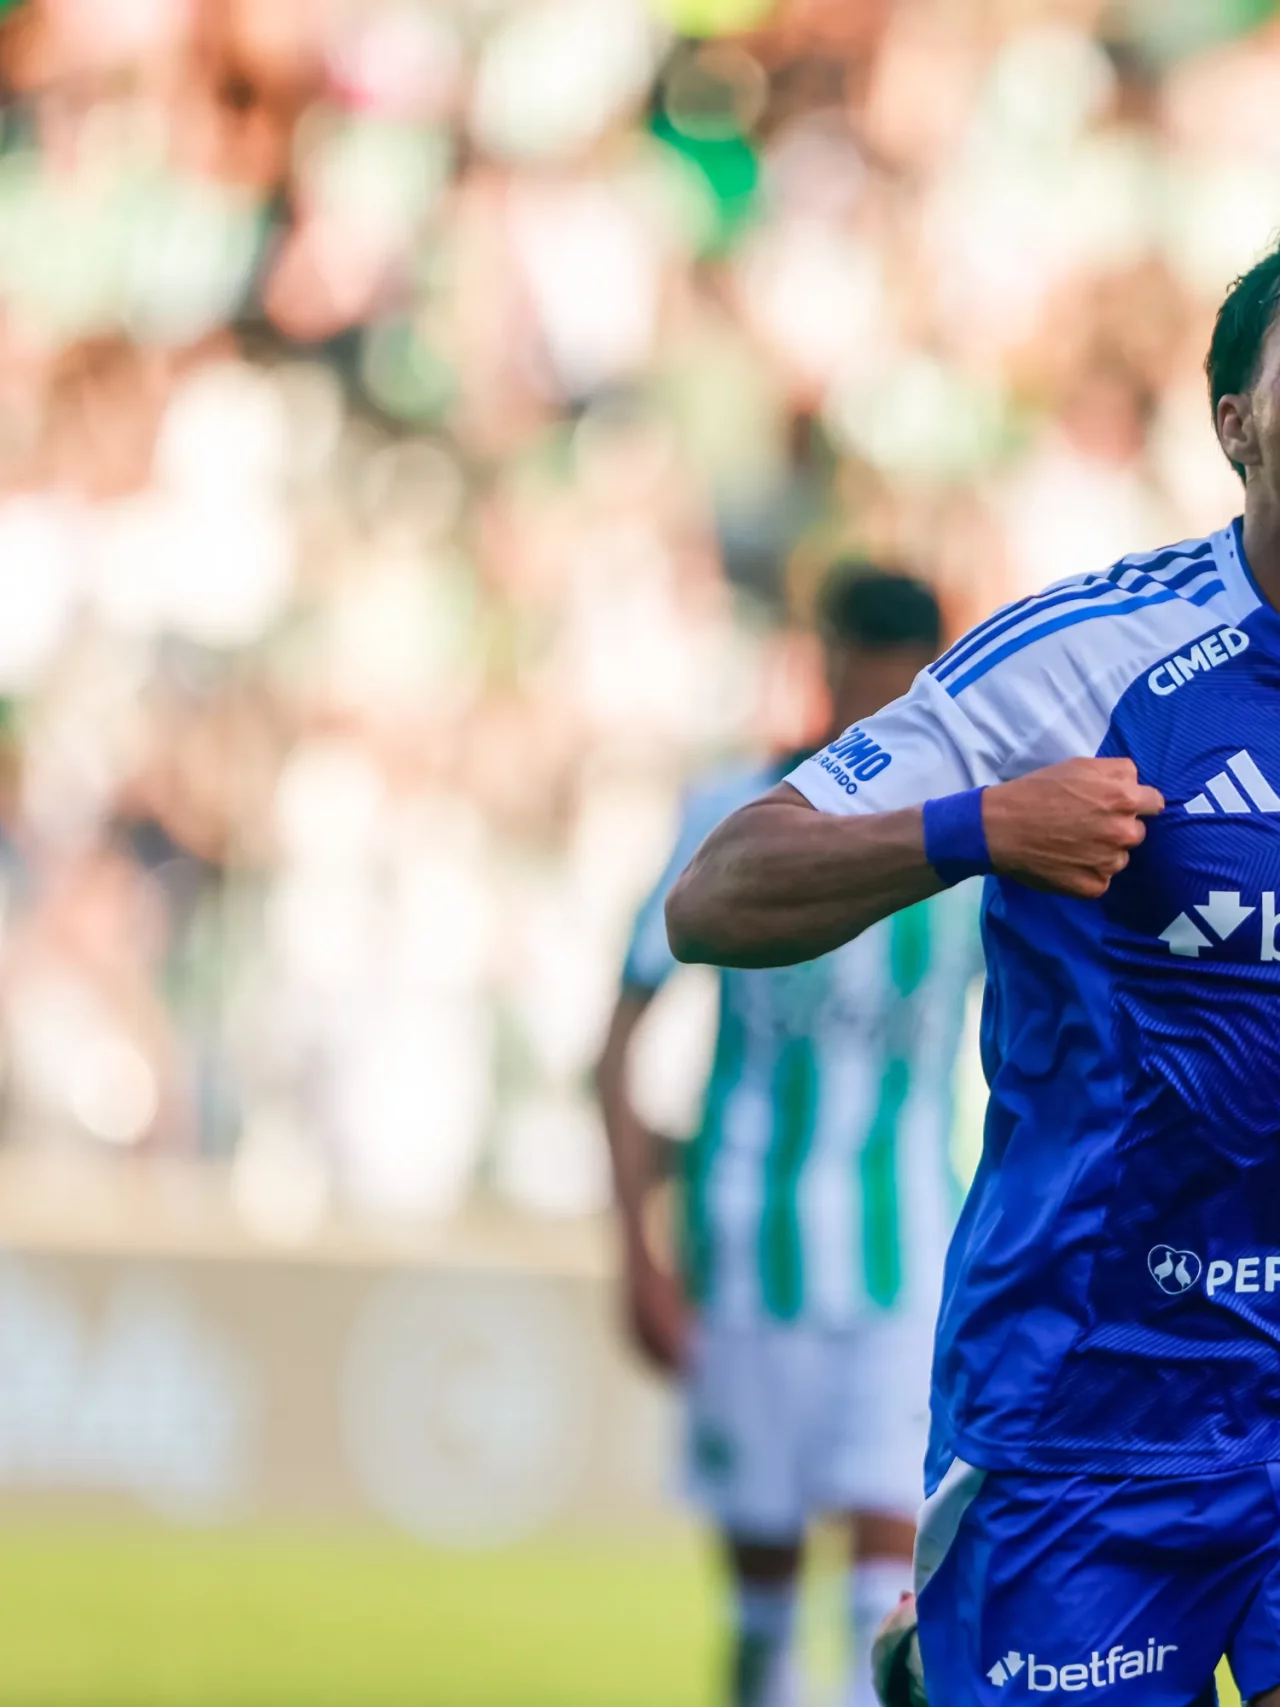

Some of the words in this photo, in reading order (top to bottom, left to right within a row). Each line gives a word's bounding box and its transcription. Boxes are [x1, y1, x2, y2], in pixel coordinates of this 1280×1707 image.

[1147, 627, 1250, 696] CIMED
[819, 756, 858, 795] RÁPIDO
[1028, 1637, 1178, 1692] betfair
